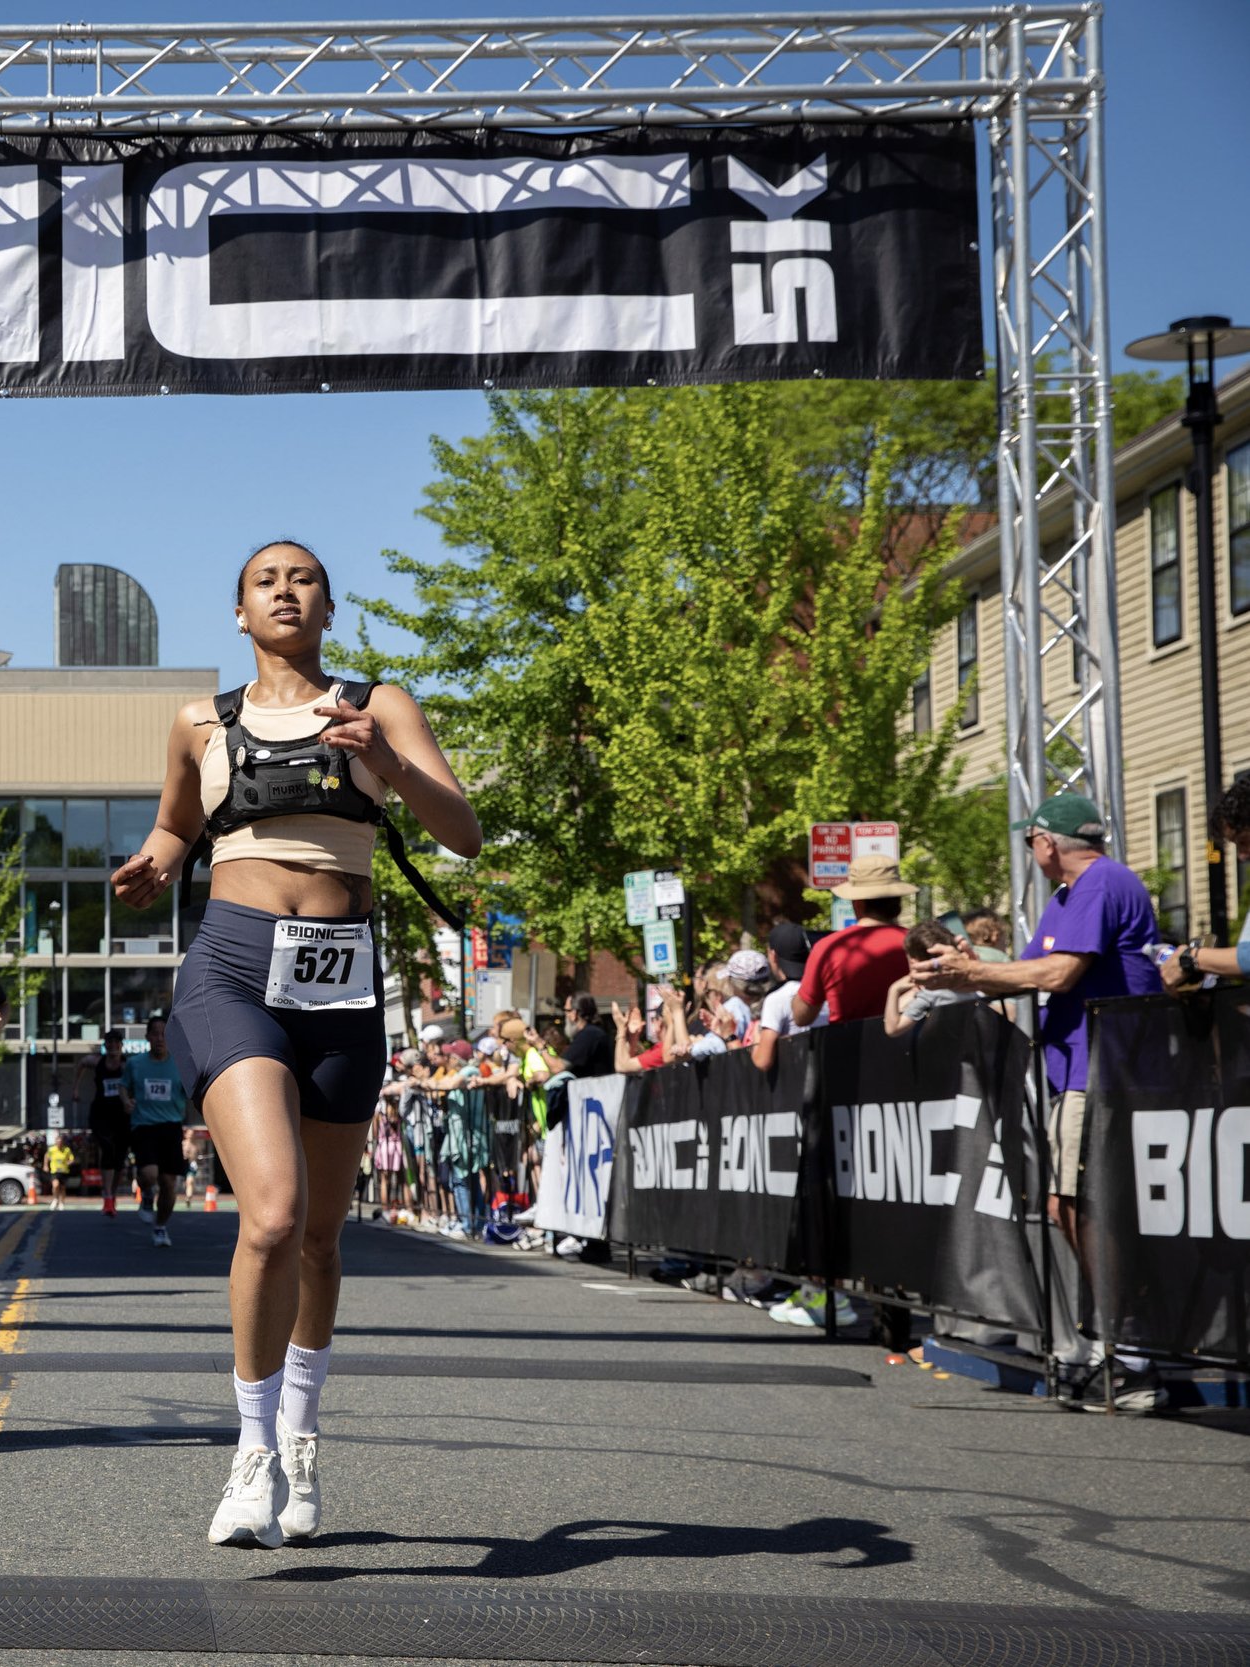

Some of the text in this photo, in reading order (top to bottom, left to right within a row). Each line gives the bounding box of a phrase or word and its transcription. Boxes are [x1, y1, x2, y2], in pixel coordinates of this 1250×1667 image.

[727, 152, 839, 345] 5K
[287, 925, 355, 940] BIONIC
[294, 946, 356, 985] 521
[272, 997, 295, 1006] FOOD
[832, 1094, 982, 1206] BIONIC
